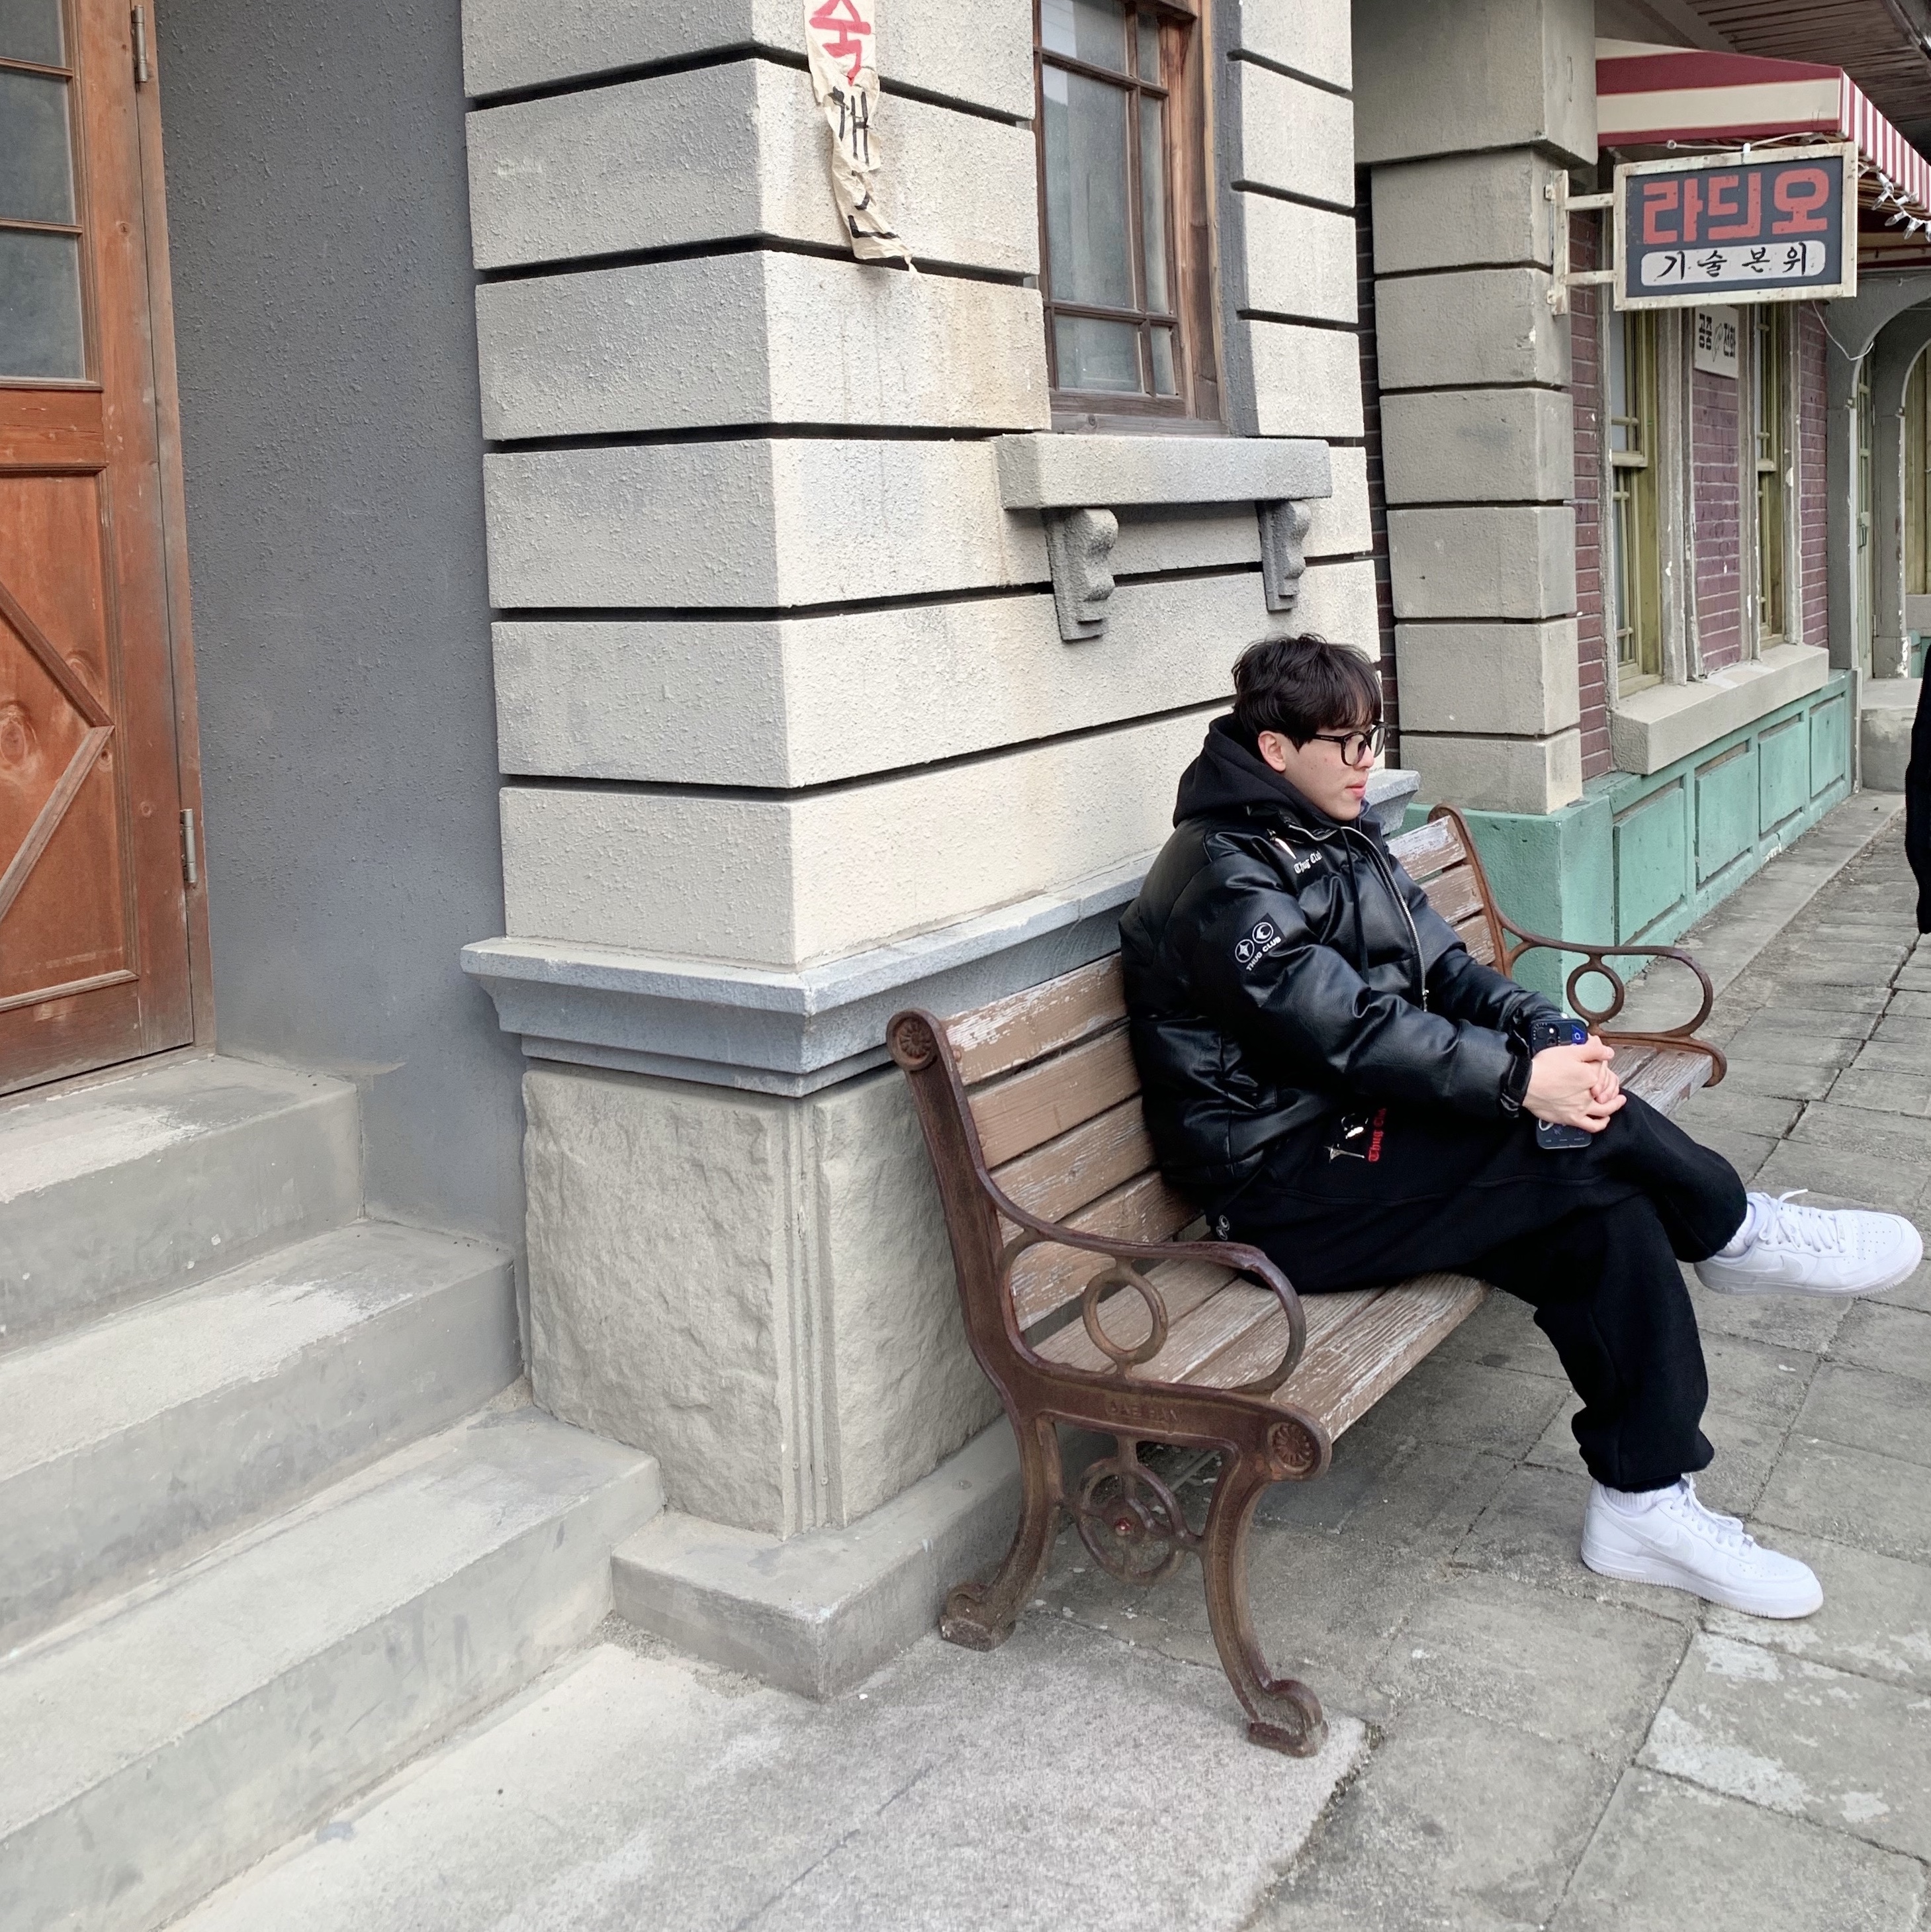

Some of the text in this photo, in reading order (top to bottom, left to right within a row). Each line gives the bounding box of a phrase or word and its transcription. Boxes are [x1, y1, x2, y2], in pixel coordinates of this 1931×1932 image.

[1642, 167, 1830, 245] 라듸오
[1653, 242, 1807, 281] 기술본위
[1699, 312, 1713, 351] 공중
[1245, 936, 1282, 972] THUG CLUB
